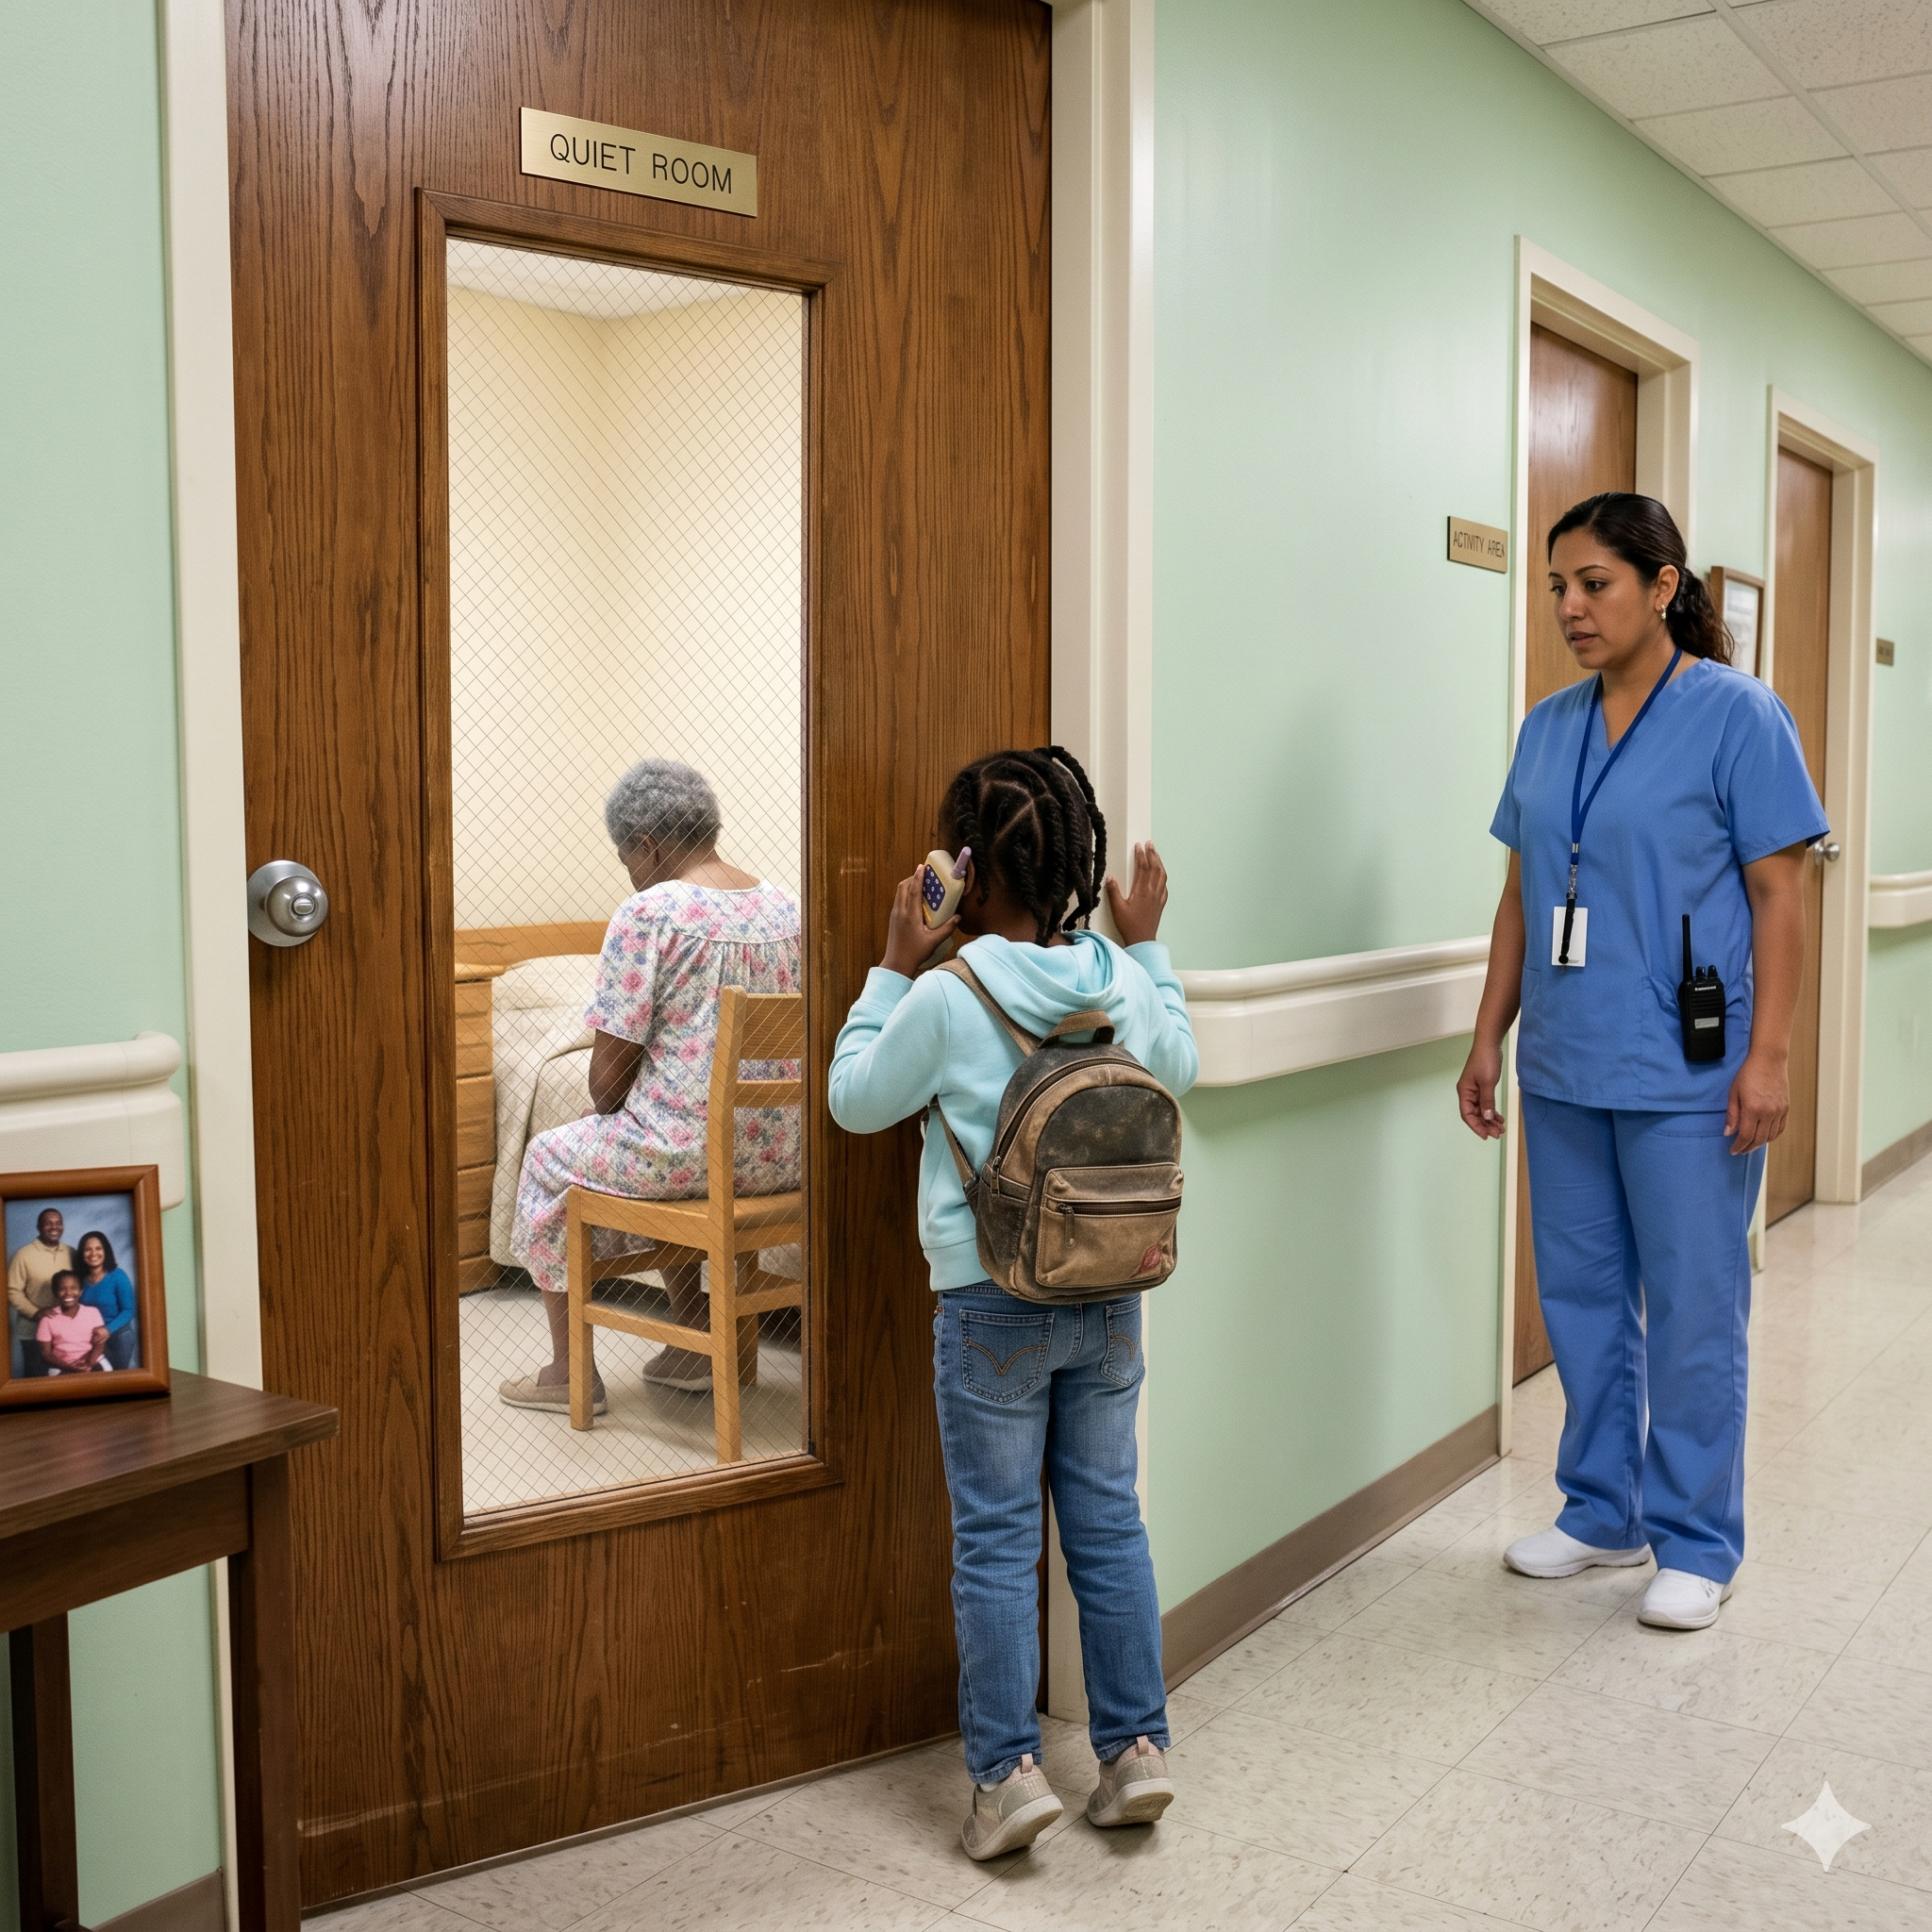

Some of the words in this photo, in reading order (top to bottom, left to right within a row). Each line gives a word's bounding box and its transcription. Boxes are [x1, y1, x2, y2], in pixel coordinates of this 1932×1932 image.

[550, 134, 636, 175] QUIET
[652, 153, 732, 194] ROOM
[1453, 530, 1485, 553] ACTIVITY
[1488, 539, 1505, 558] AREA
